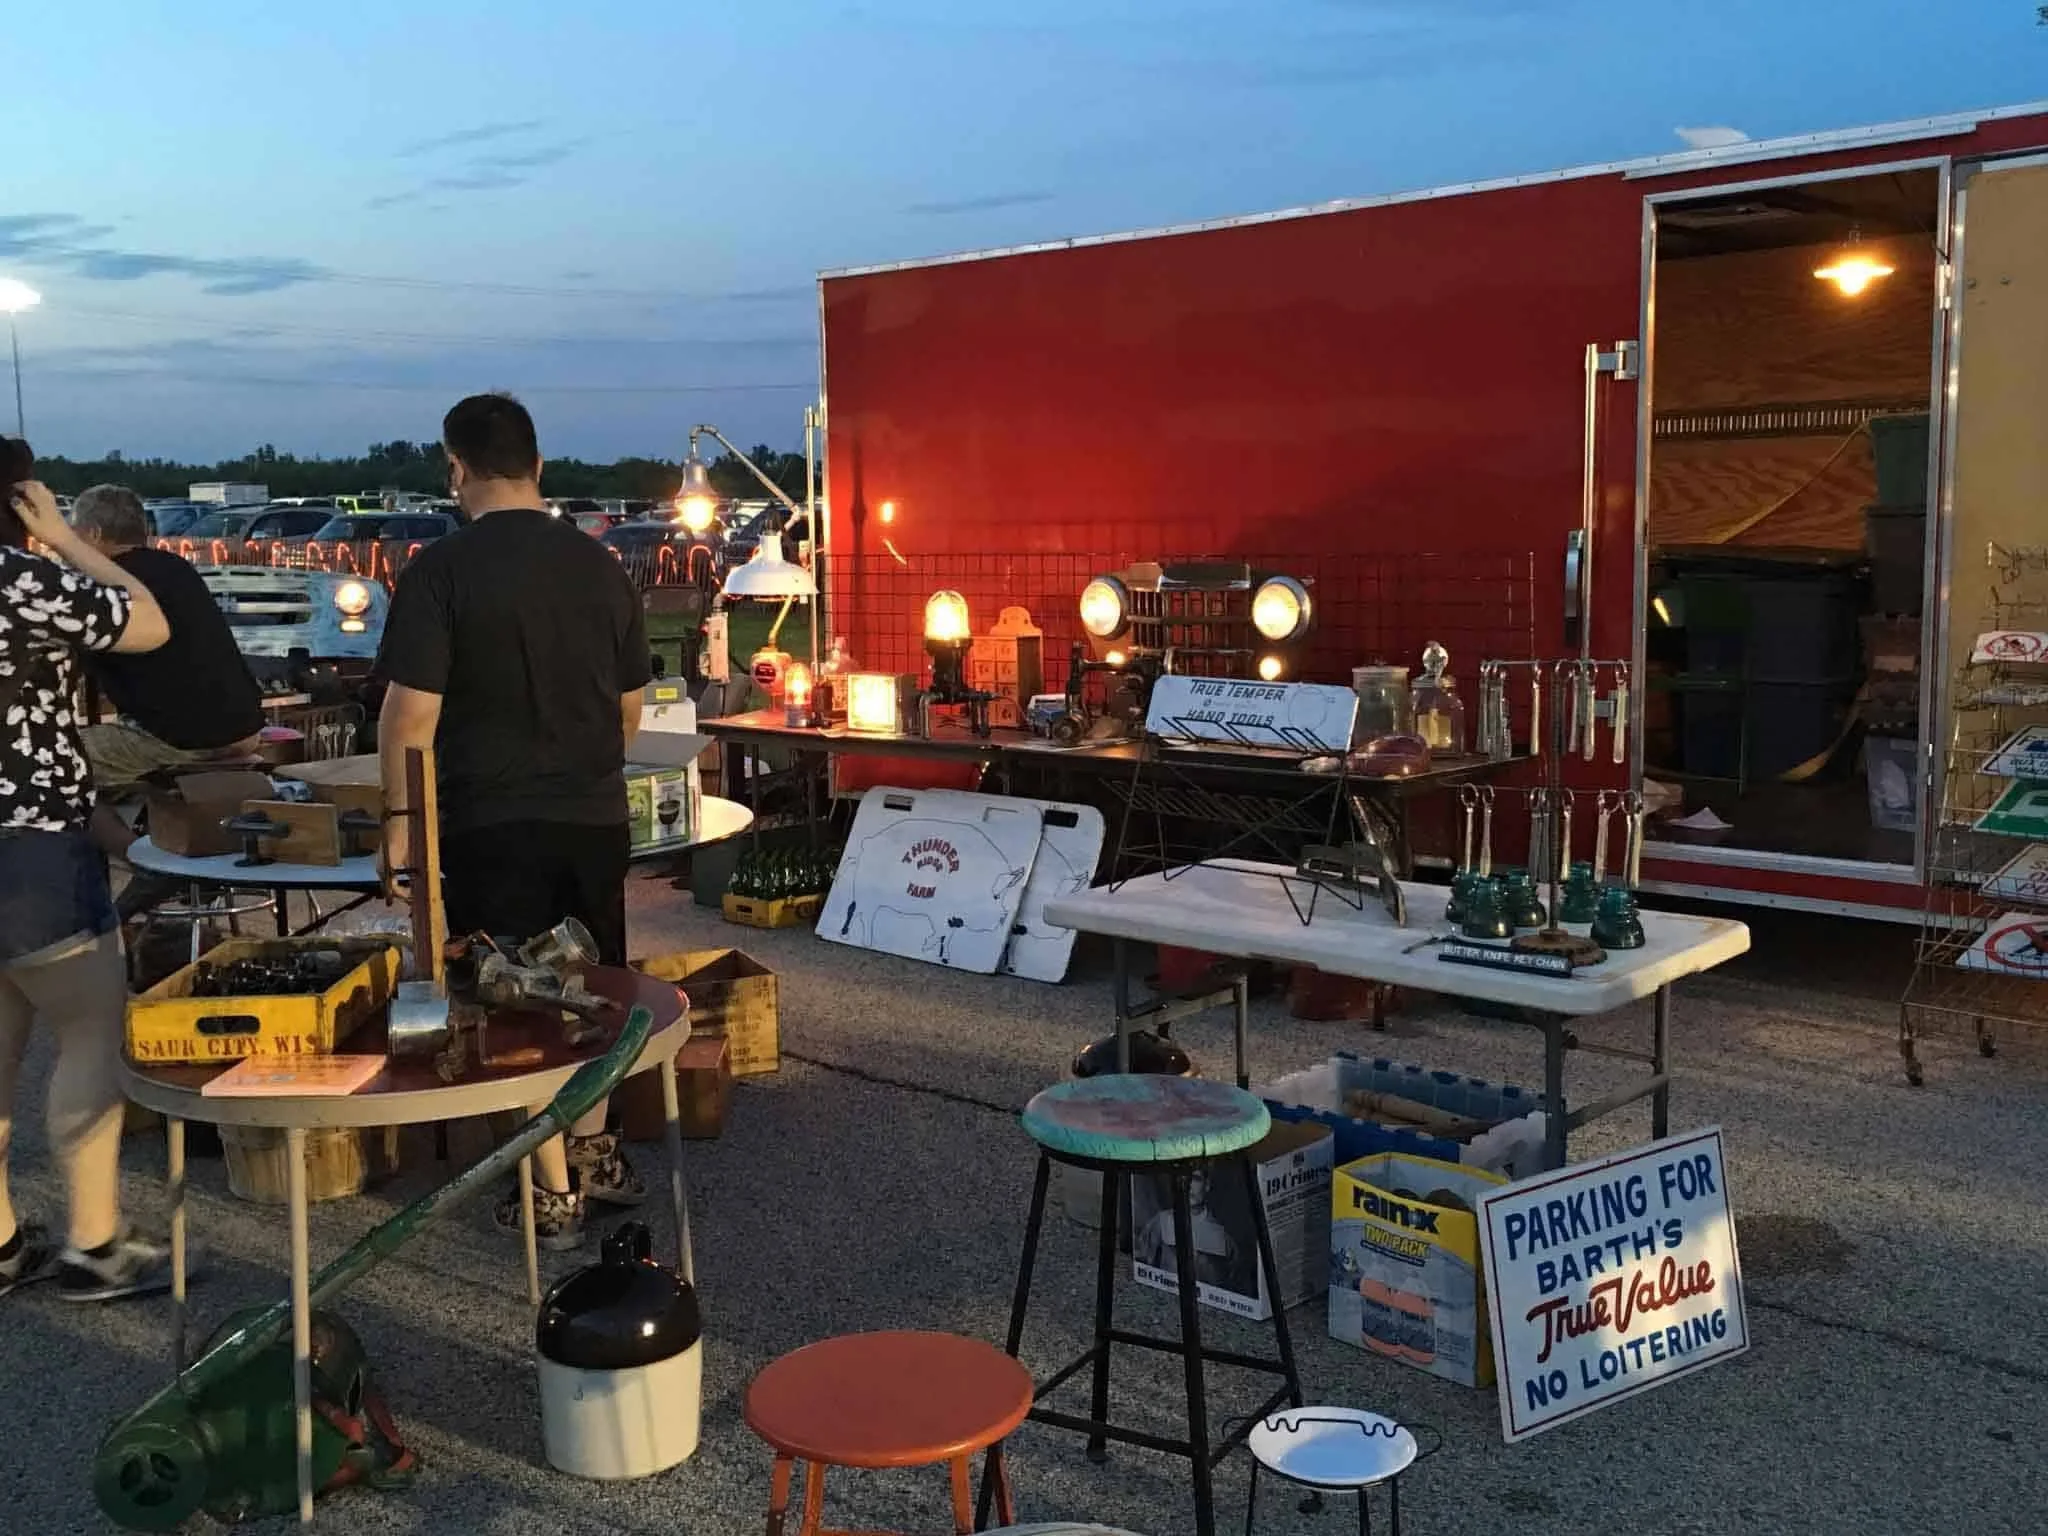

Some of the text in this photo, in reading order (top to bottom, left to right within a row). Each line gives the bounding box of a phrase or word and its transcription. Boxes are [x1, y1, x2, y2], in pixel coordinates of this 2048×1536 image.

[1191, 678, 1289, 701] TRUE TEMPER
[1231, 712, 1275, 727] TOOLS
[902, 838, 960, 874] THUNDER
[907, 883, 936, 898] FARM
[1443, 943, 1480, 960] BUTTER
[1504, 1174, 1648, 1261] PARKING
[1658, 1153, 1717, 1209] FOR
[1536, 1217, 1684, 1296] BARTH'S
[1526, 1308, 1727, 1411] NO LOITERING
